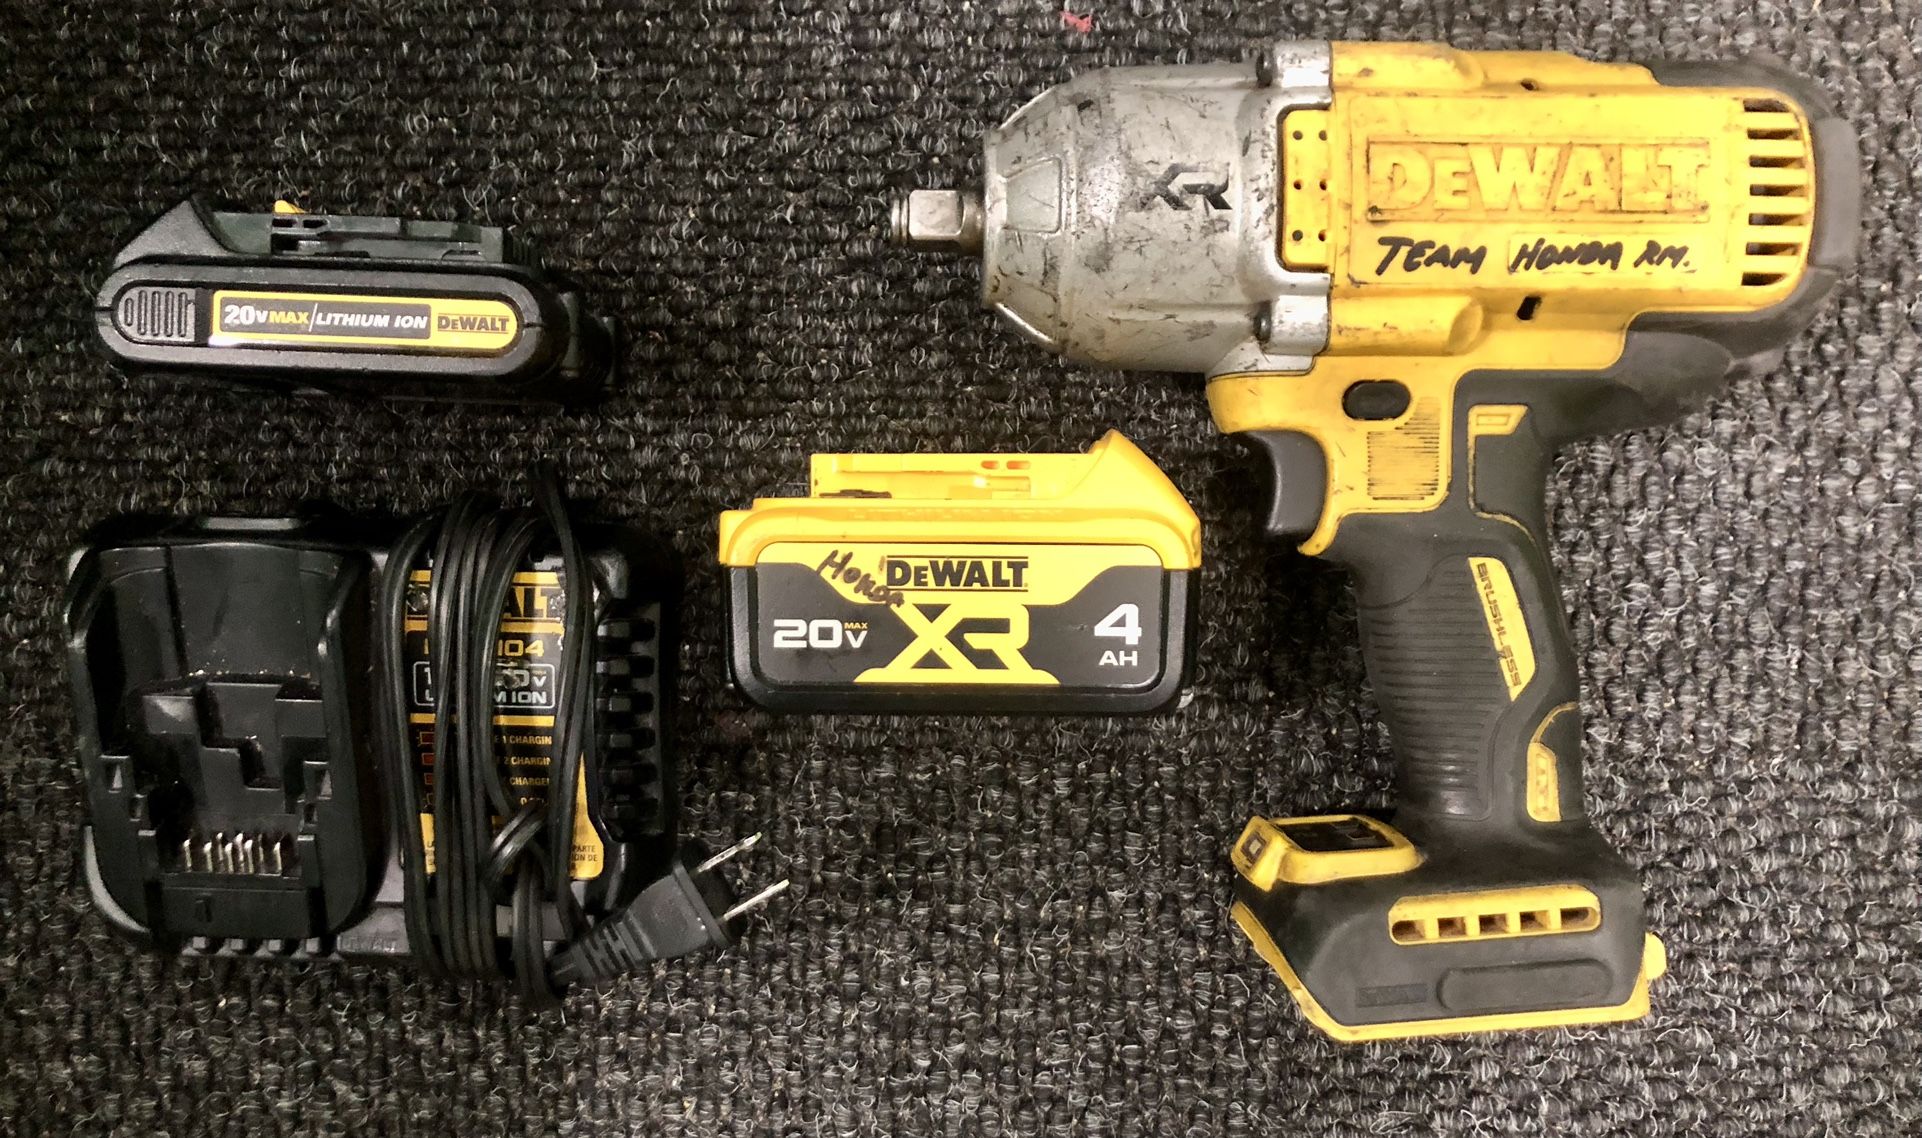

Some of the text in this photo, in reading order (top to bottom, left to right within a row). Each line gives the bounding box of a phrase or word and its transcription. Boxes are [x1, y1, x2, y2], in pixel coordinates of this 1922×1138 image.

[1375, 236, 1487, 275] TEAM
[315, 312, 390, 327] LITHIUM
[393, 315, 428, 329] ION
[876, 603, 1035, 672] XR
[1093, 603, 1142, 646] 4
[1476, 562, 1522, 687] BRUSHLESS
[1098, 650, 1138, 666] AH
[509, 732, 553, 745] CHARGIN
[509, 777, 550, 786] CHARGE
